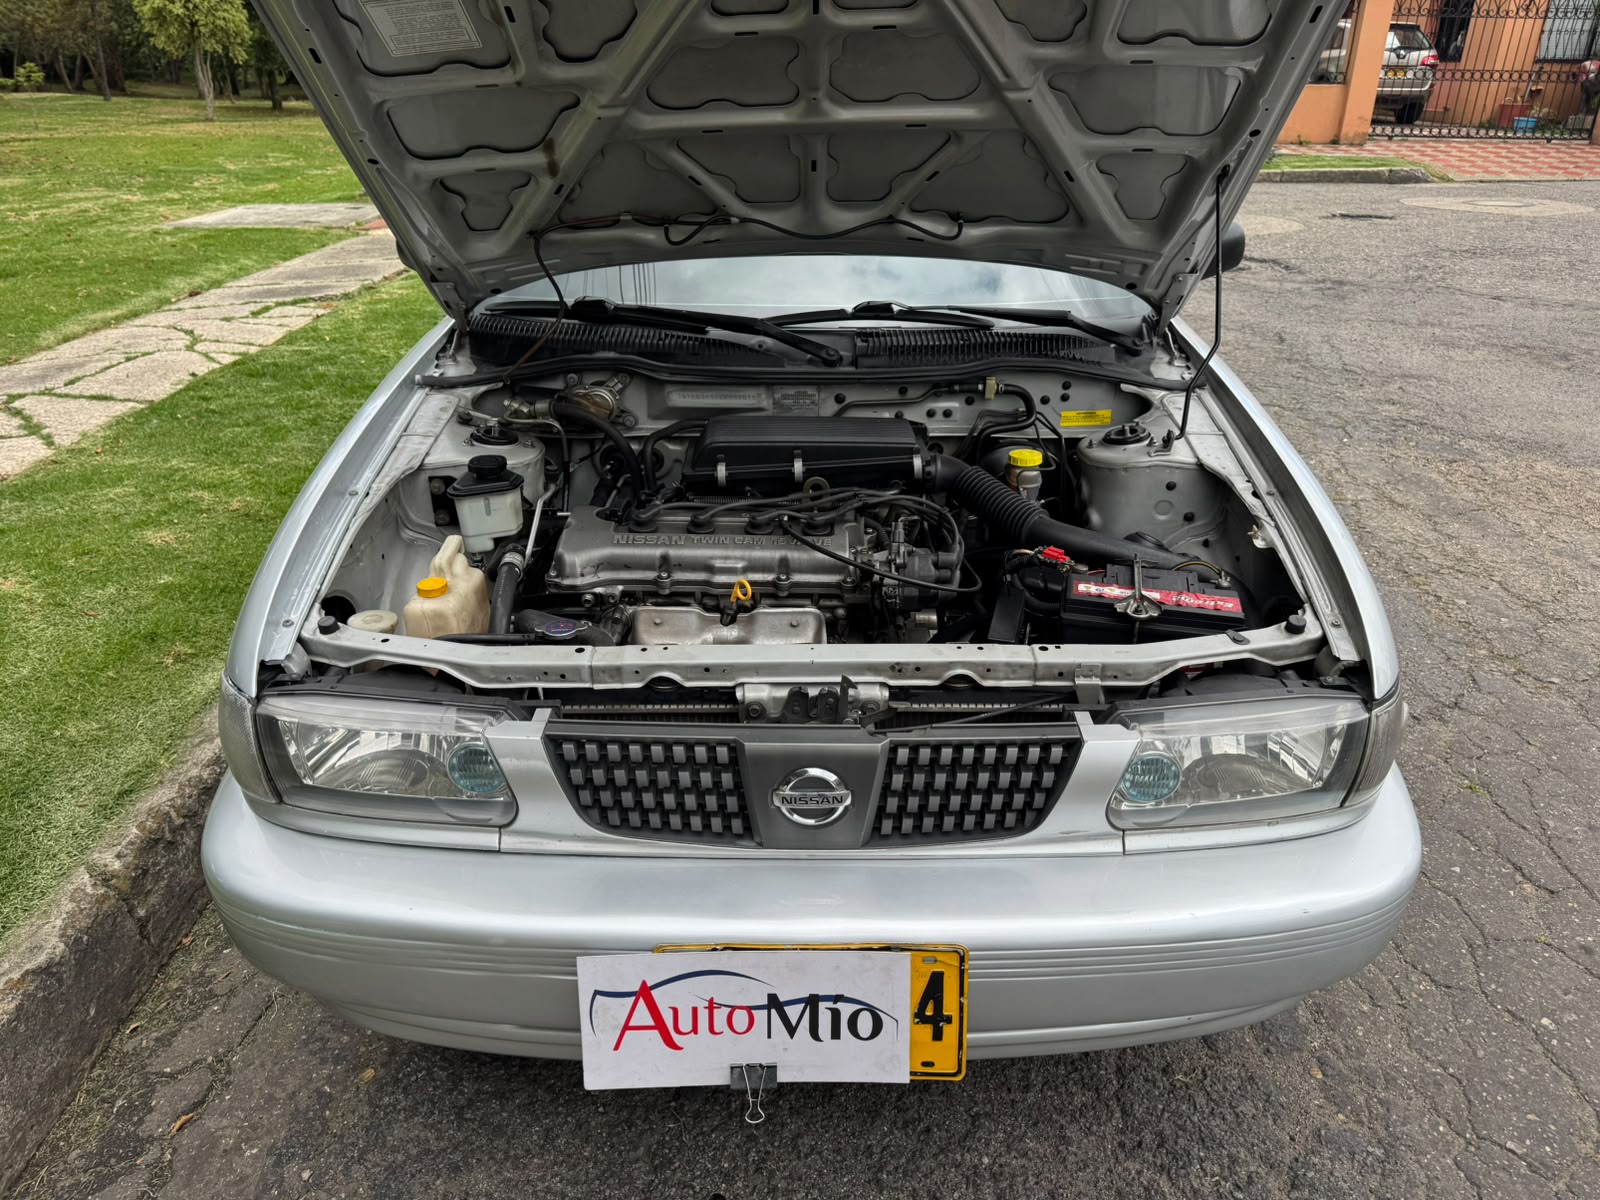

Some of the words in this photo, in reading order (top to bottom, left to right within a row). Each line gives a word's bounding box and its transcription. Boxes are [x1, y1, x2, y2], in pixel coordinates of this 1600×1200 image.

[613, 534, 685, 545] NISSAN
[691, 535, 730, 544] TWIN
[734, 536, 766, 545] CAM
[781, 795, 844, 806] NISSAN
[612, 979, 756, 1052] Auto
